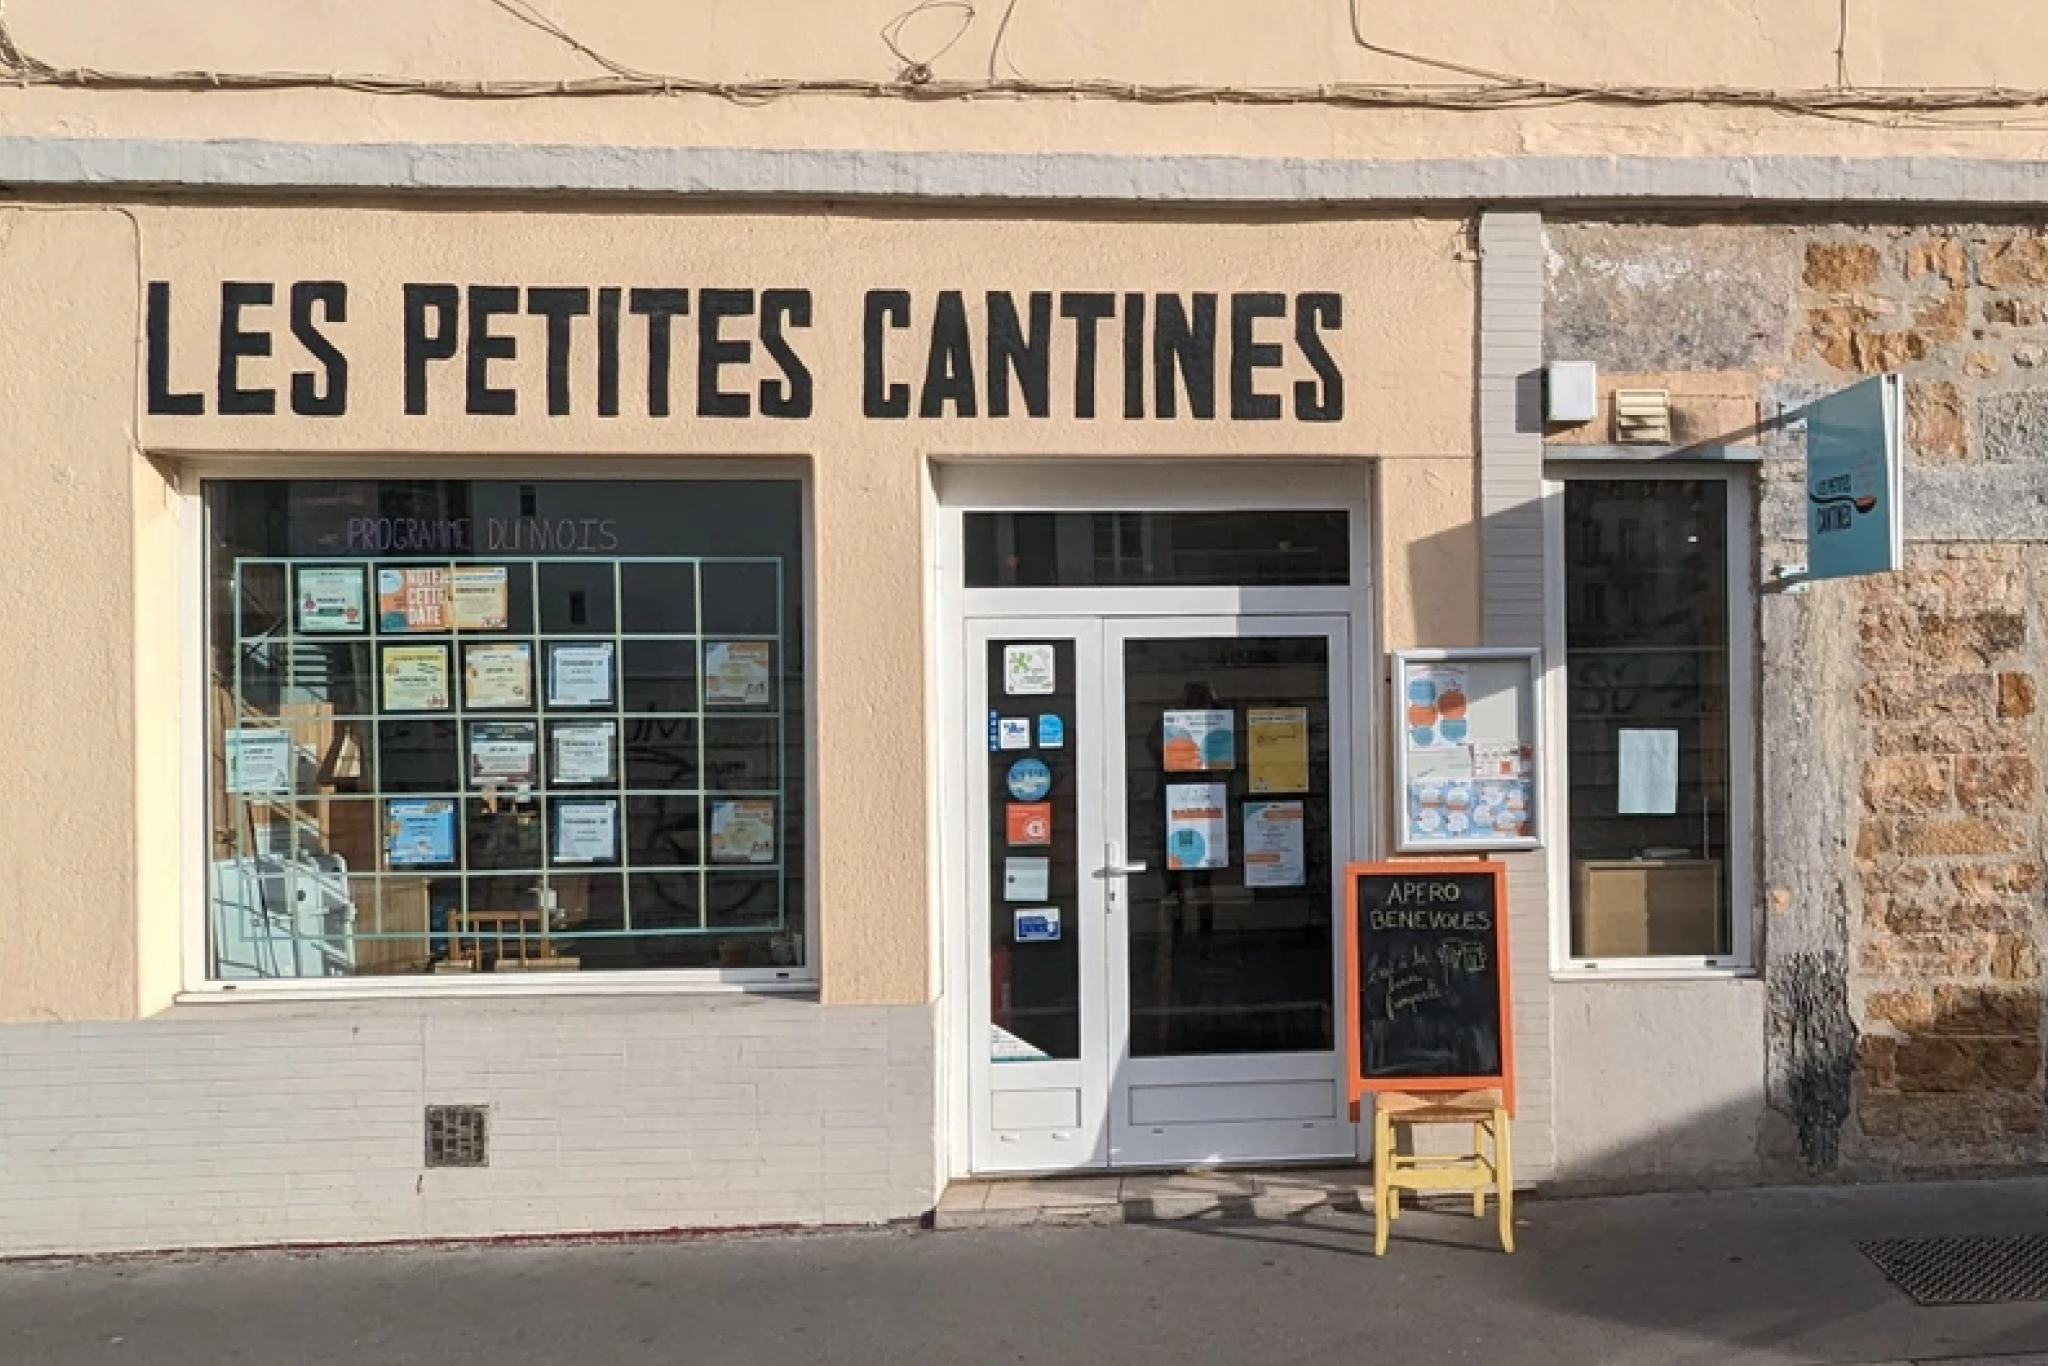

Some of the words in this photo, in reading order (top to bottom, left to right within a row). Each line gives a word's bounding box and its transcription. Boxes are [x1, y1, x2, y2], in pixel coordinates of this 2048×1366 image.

[147, 280, 348, 417] LES
[402, 282, 814, 419] PETITES
[863, 288, 1344, 421] CANTINES
[487, 518, 521, 551] DU
[529, 517, 619, 551] MOIS
[408, 605, 442, 626] DATE
[1387, 882, 1461, 904] APERO
[1371, 910, 1490, 930] BENEVOLES
